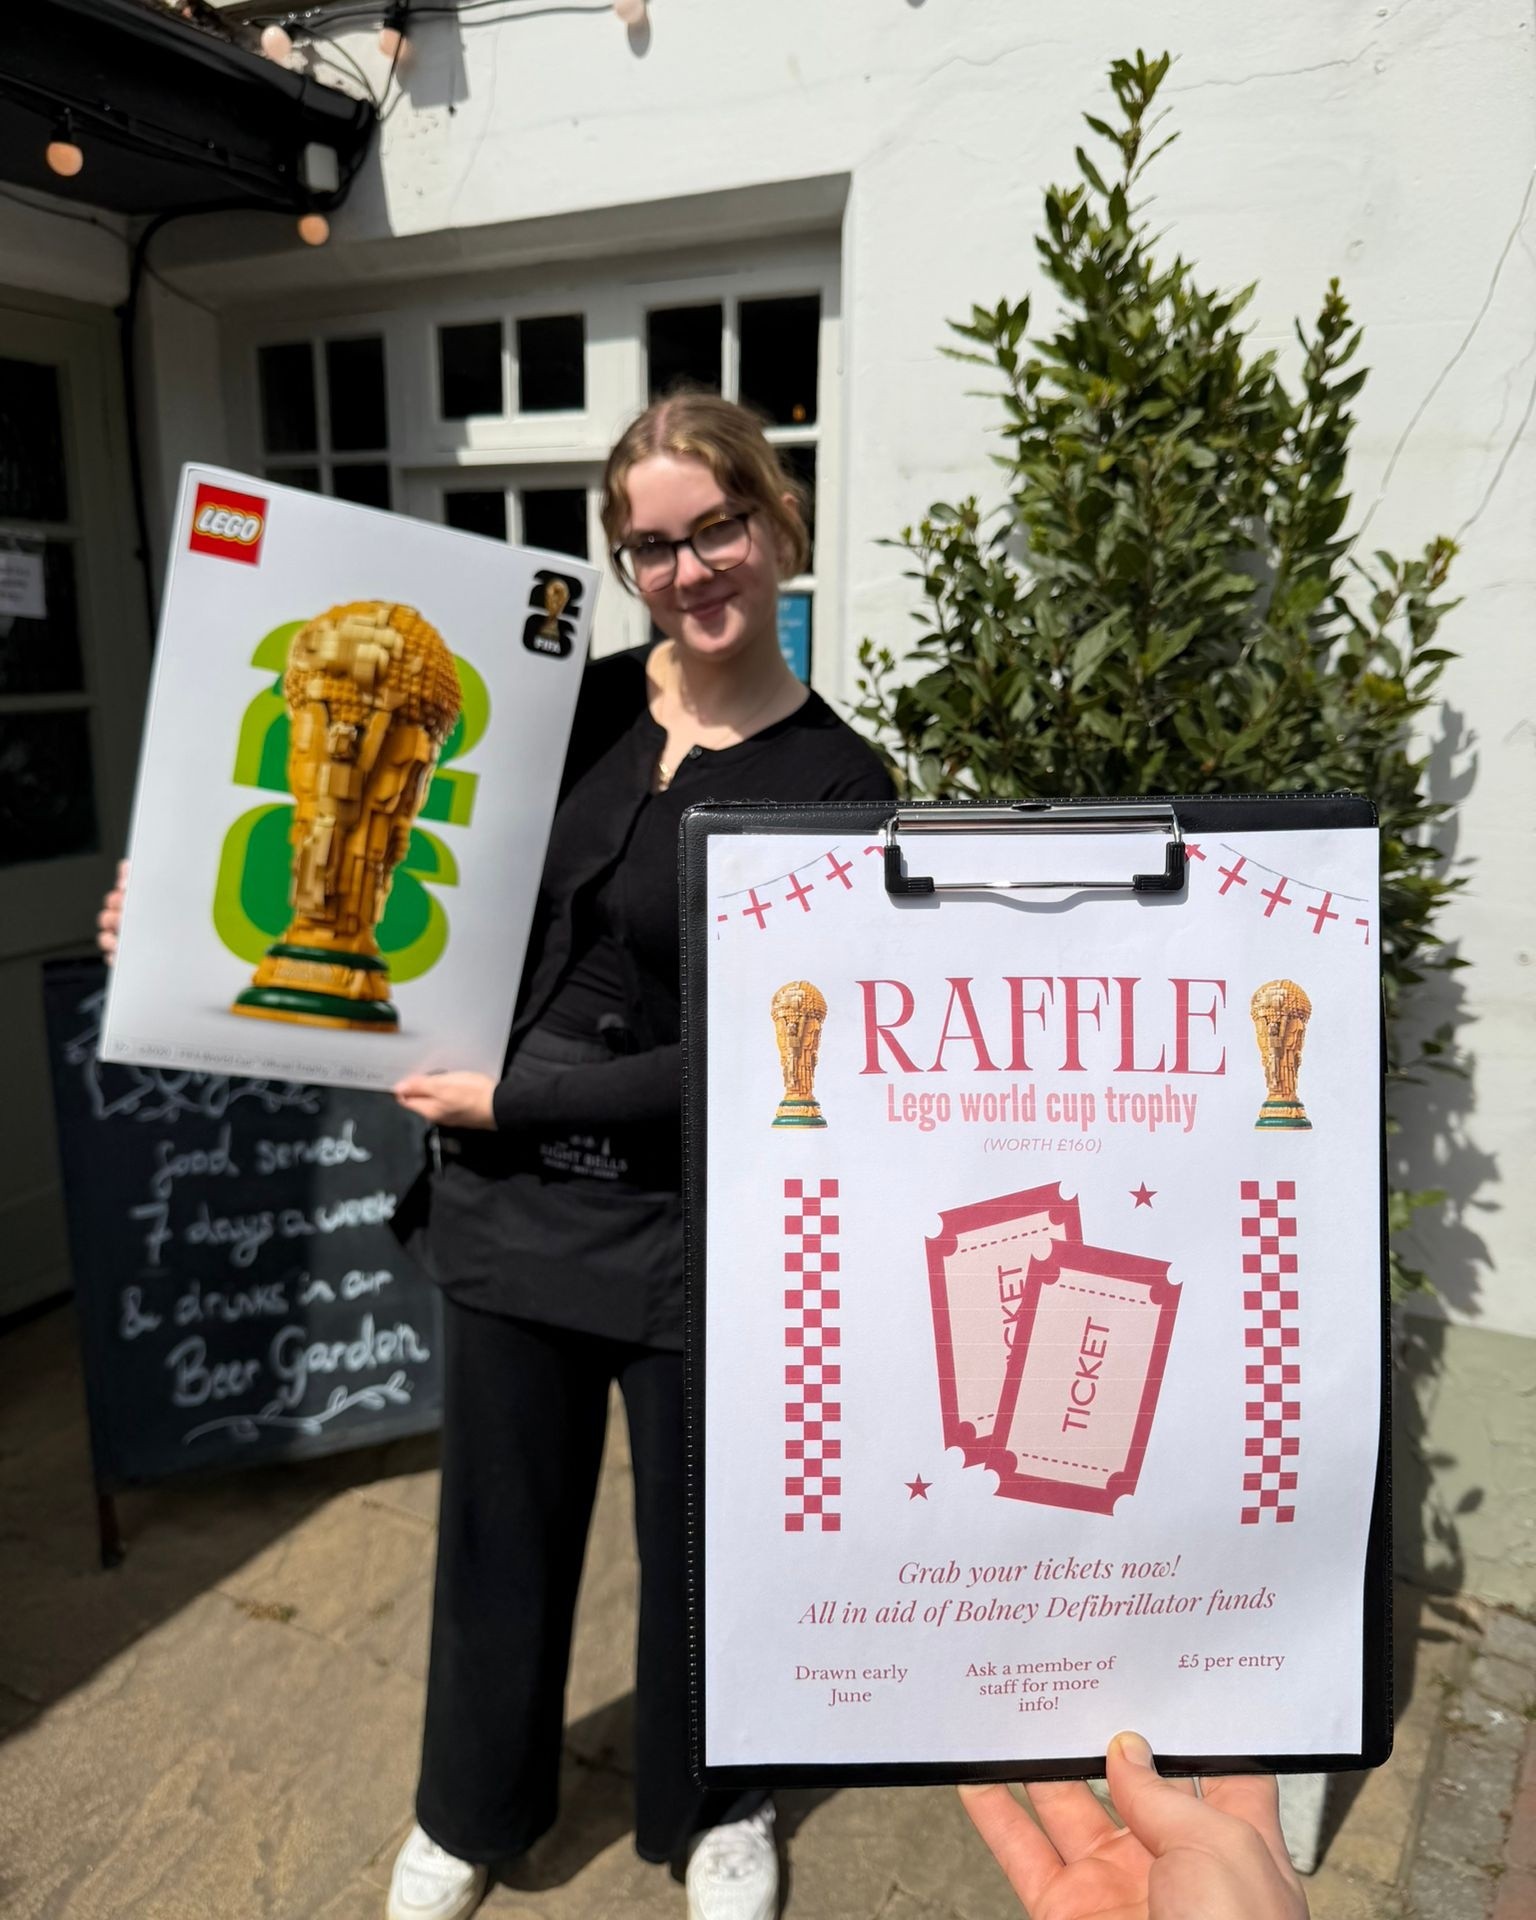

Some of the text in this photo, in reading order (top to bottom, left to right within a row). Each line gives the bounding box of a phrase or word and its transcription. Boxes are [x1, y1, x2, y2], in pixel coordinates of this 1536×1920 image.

[198, 508, 260, 541] LEGO
[855, 976, 1227, 1075] RAFFLE
[887, 1083, 1197, 1133] Lego world cup trophy
[255, 1119, 372, 1174] served
[983, 1138, 1102, 1154] (WORTH £160)
[130, 1203, 172, 1265] 7
[187, 1205, 274, 1268] days
[315, 1193, 397, 1232] week
[175, 1279, 288, 1325] drinks
[301, 1273, 336, 1302] in
[341, 1269, 393, 1298] our
[166, 1313, 430, 1408] Beer Garden
[1062, 1316, 1110, 1432] TICKET
[898, 1555, 1181, 1588] Grab your tickets now!
[798, 1586, 1276, 1627] All in aid of Bolney Defibrillator funds
[795, 1664, 908, 1683] Drawn early
[965, 1656, 1117, 1677] Ask a member of
[1178, 1654, 1285, 1672] £5 per entry
[828, 1688, 872, 1706] June
[979, 1678, 1100, 1695] staff for more
[1018, 1696, 1059, 1712] info!
